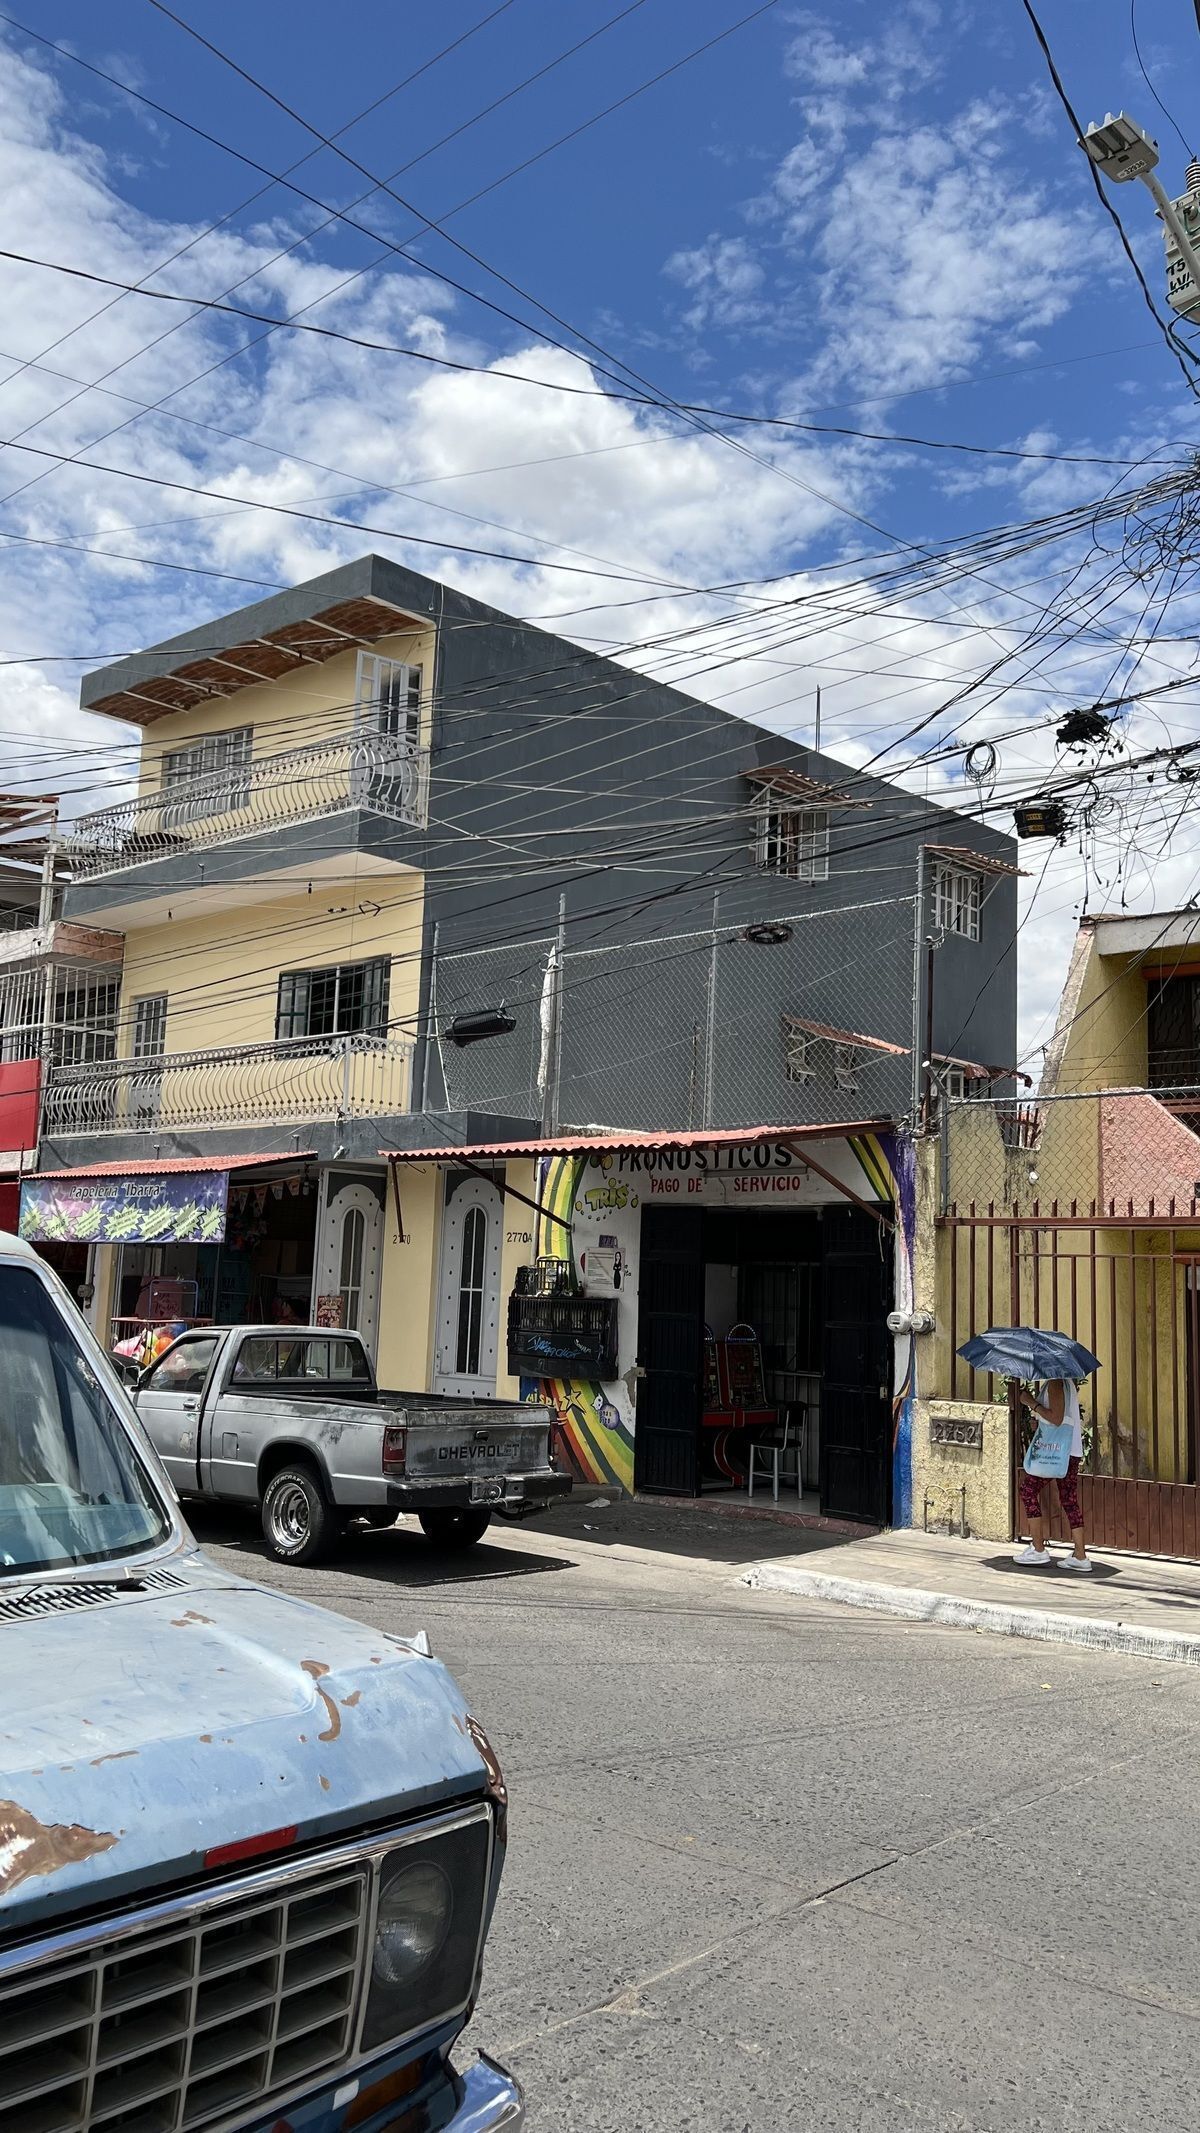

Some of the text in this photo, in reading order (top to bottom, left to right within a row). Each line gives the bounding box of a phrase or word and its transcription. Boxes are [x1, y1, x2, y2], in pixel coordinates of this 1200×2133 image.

[650, 1175, 800, 1194] PAGO DE SERVICIO
[506, 1231, 533, 1243] 2770A
[438, 1444, 520, 1460] CHEVROLET
